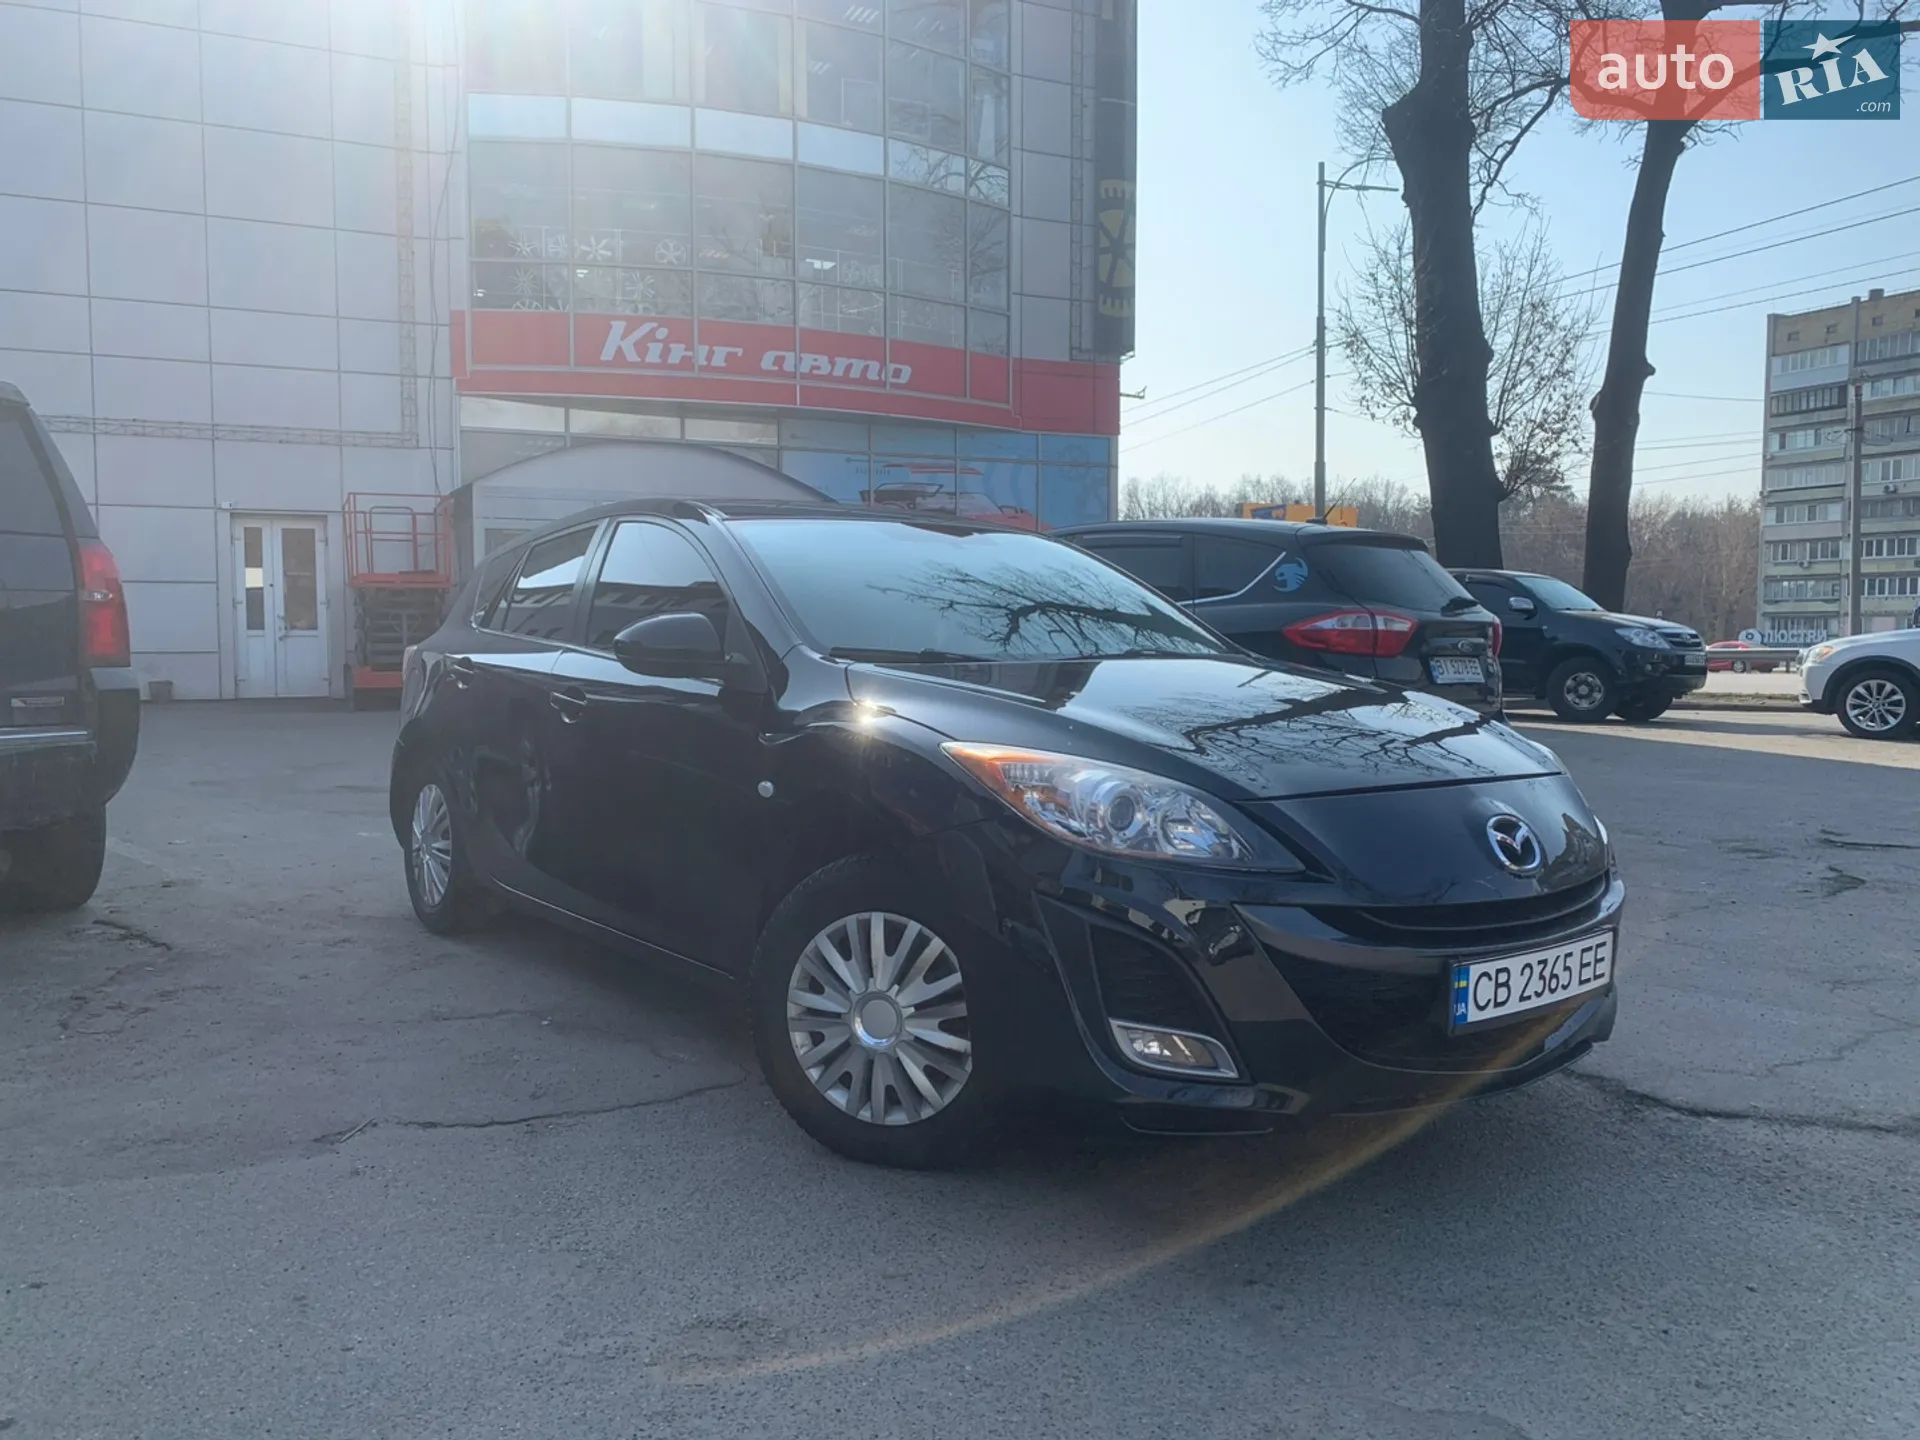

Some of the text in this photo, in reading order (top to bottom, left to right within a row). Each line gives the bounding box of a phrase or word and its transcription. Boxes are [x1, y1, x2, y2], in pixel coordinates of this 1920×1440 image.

[600, 320, 912, 385] Кінг авто
[1763, 629, 1828, 643] ЛЮСТРИ
[1473, 941, 1607, 1012] CB 2365 EE
